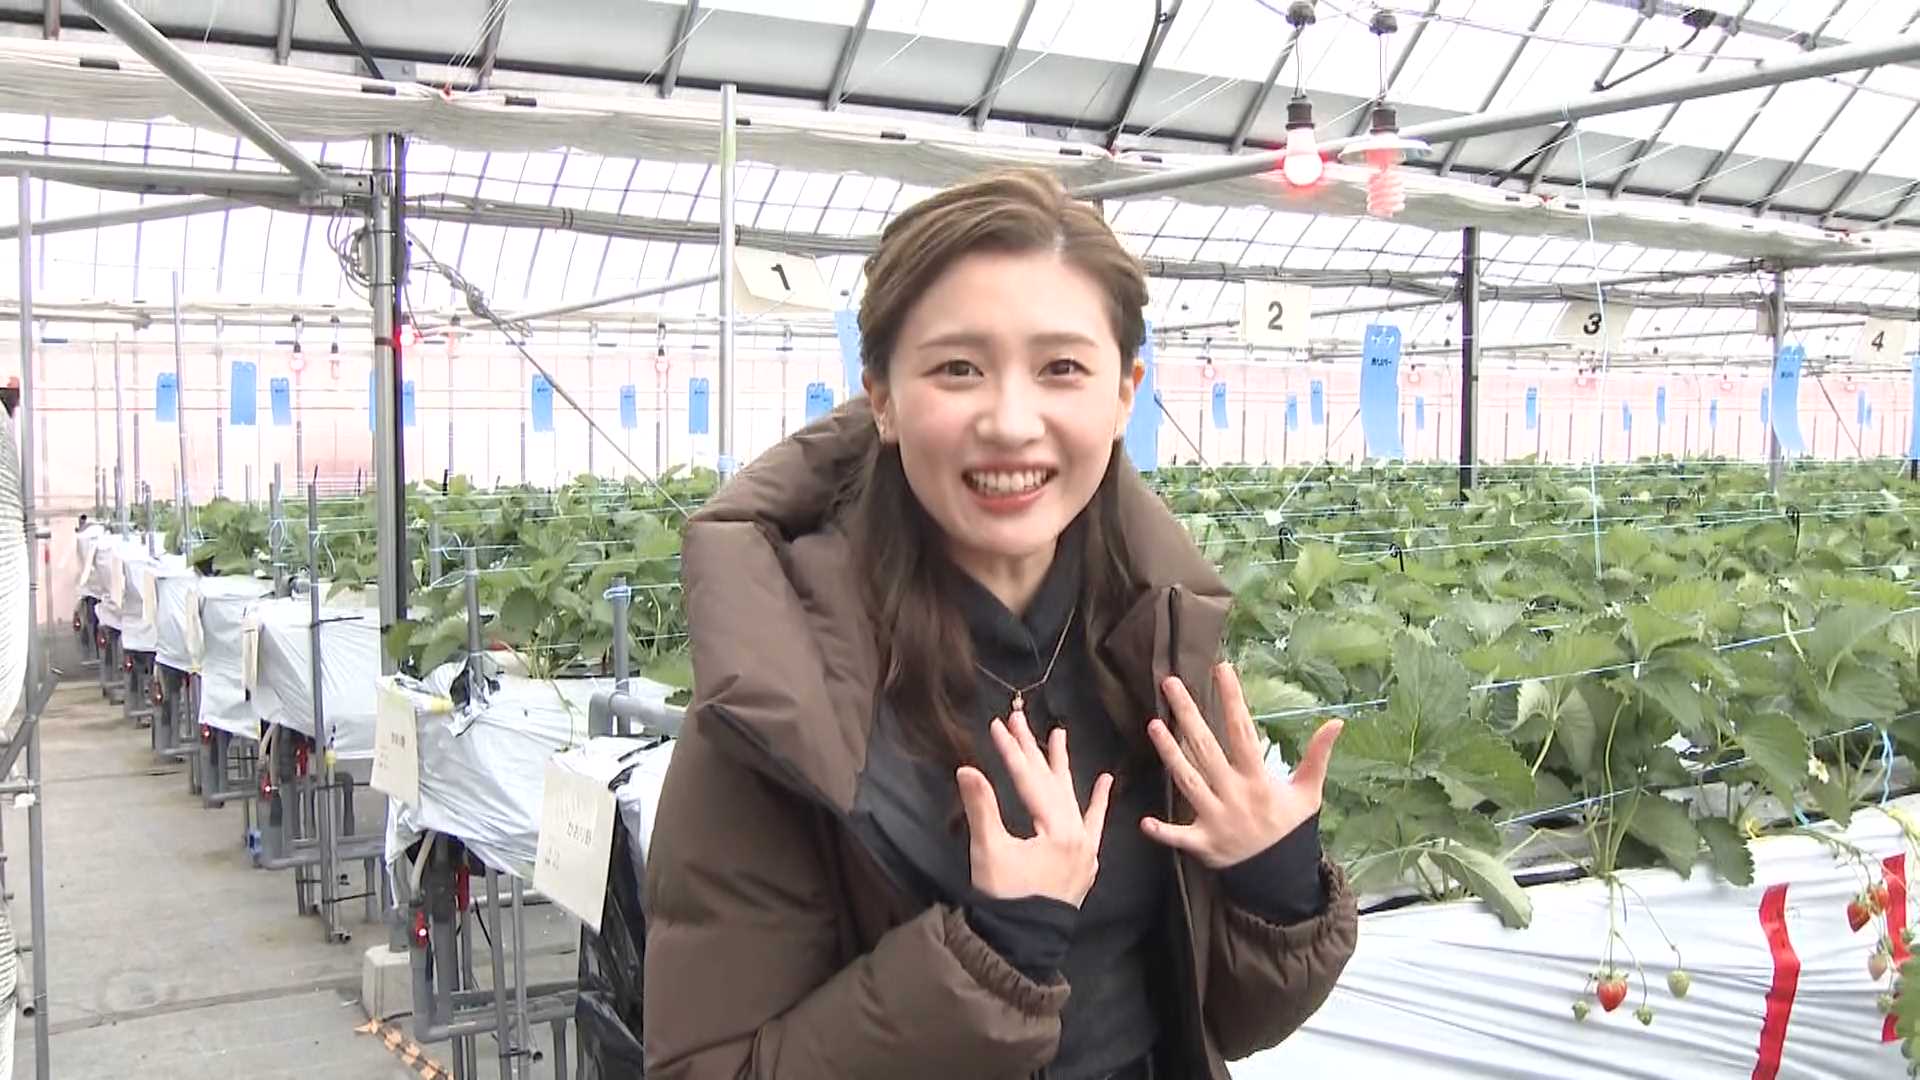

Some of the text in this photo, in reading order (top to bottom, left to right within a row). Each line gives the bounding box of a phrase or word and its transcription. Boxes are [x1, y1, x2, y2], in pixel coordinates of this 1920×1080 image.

[770, 263, 791, 291] 1
[1267, 300, 1283, 331] 2
[1583, 313, 1602, 335] 3
[1871, 330, 1885, 352] 4
